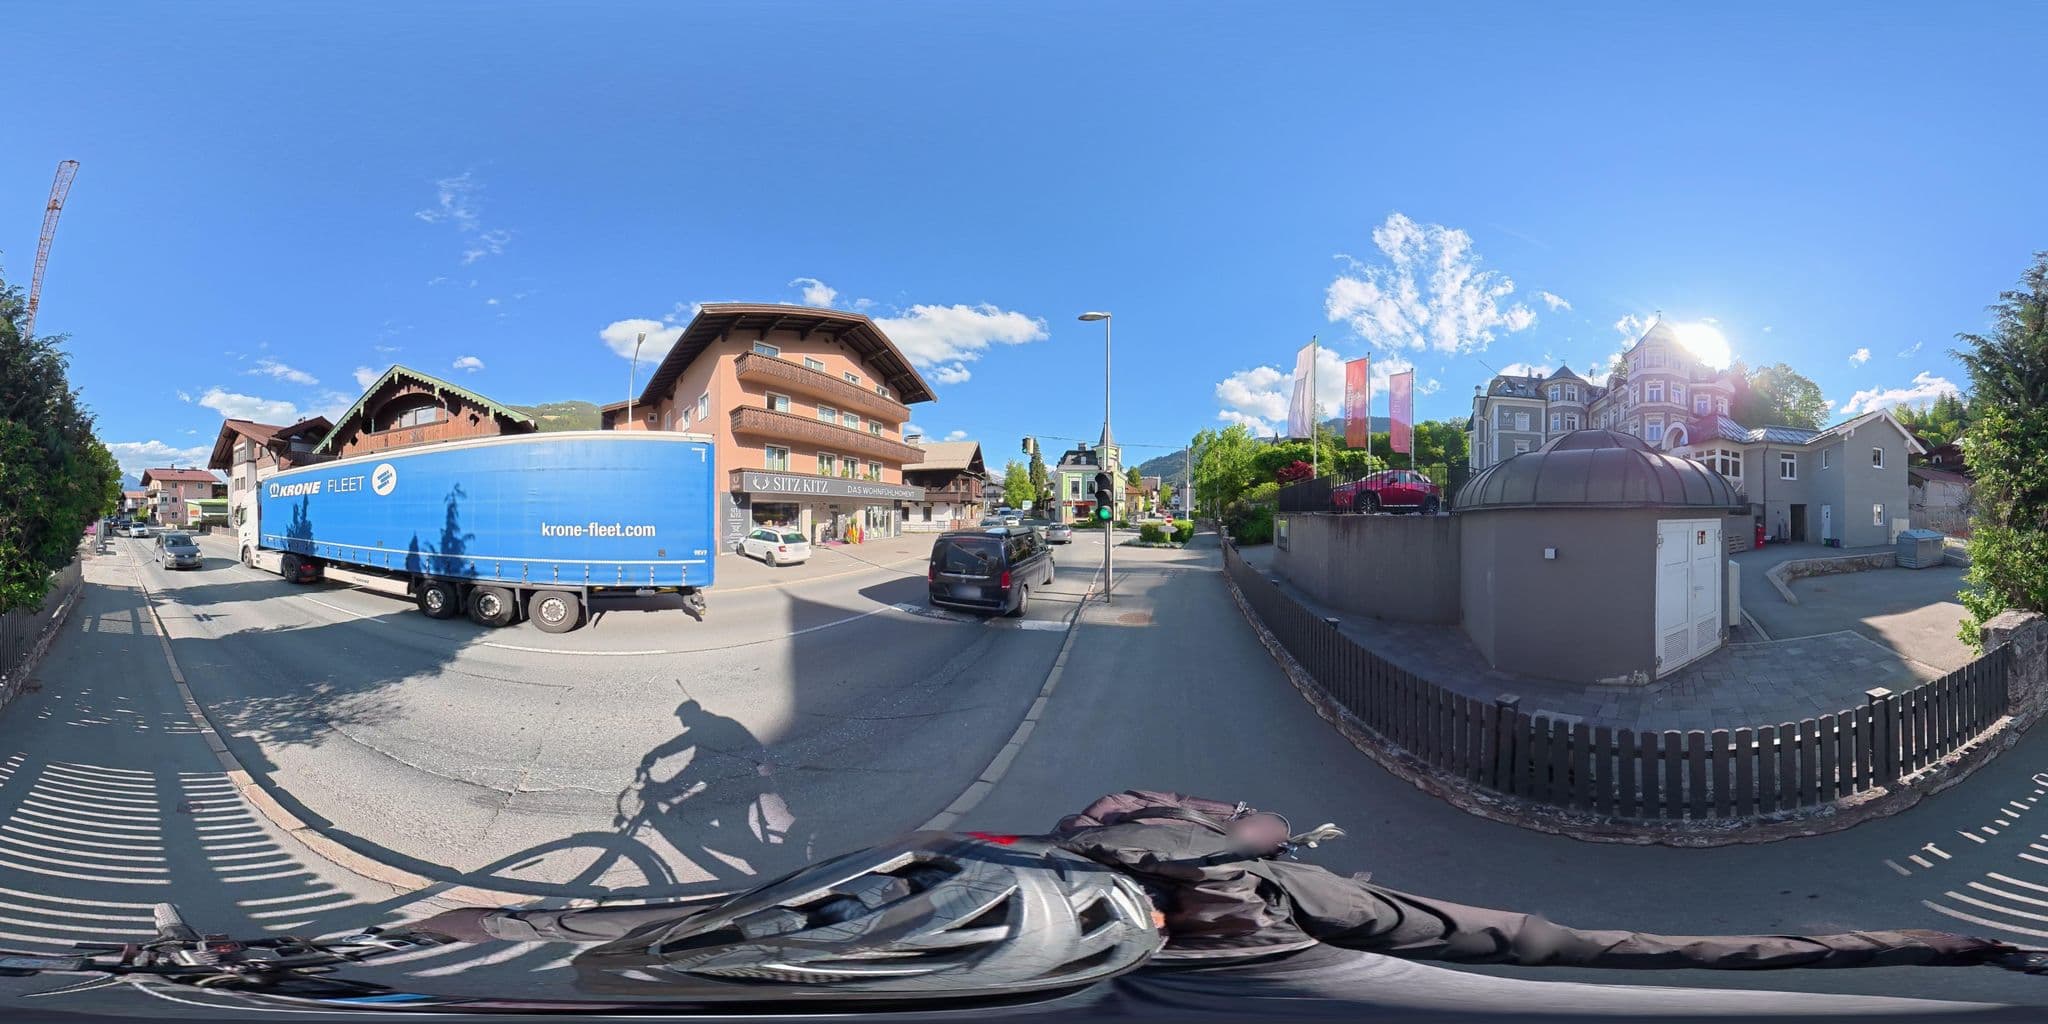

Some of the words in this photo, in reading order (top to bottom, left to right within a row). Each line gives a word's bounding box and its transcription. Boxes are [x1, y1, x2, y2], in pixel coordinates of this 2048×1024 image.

[280, 481, 321, 497] KRONE
[327, 476, 365, 493] FLEET
[774, 477, 801, 492] SITZ
[803, 478, 828, 494] KITZ
[847, 485, 861, 494] DAS
[541, 522, 656, 537] krone-fleet.com
